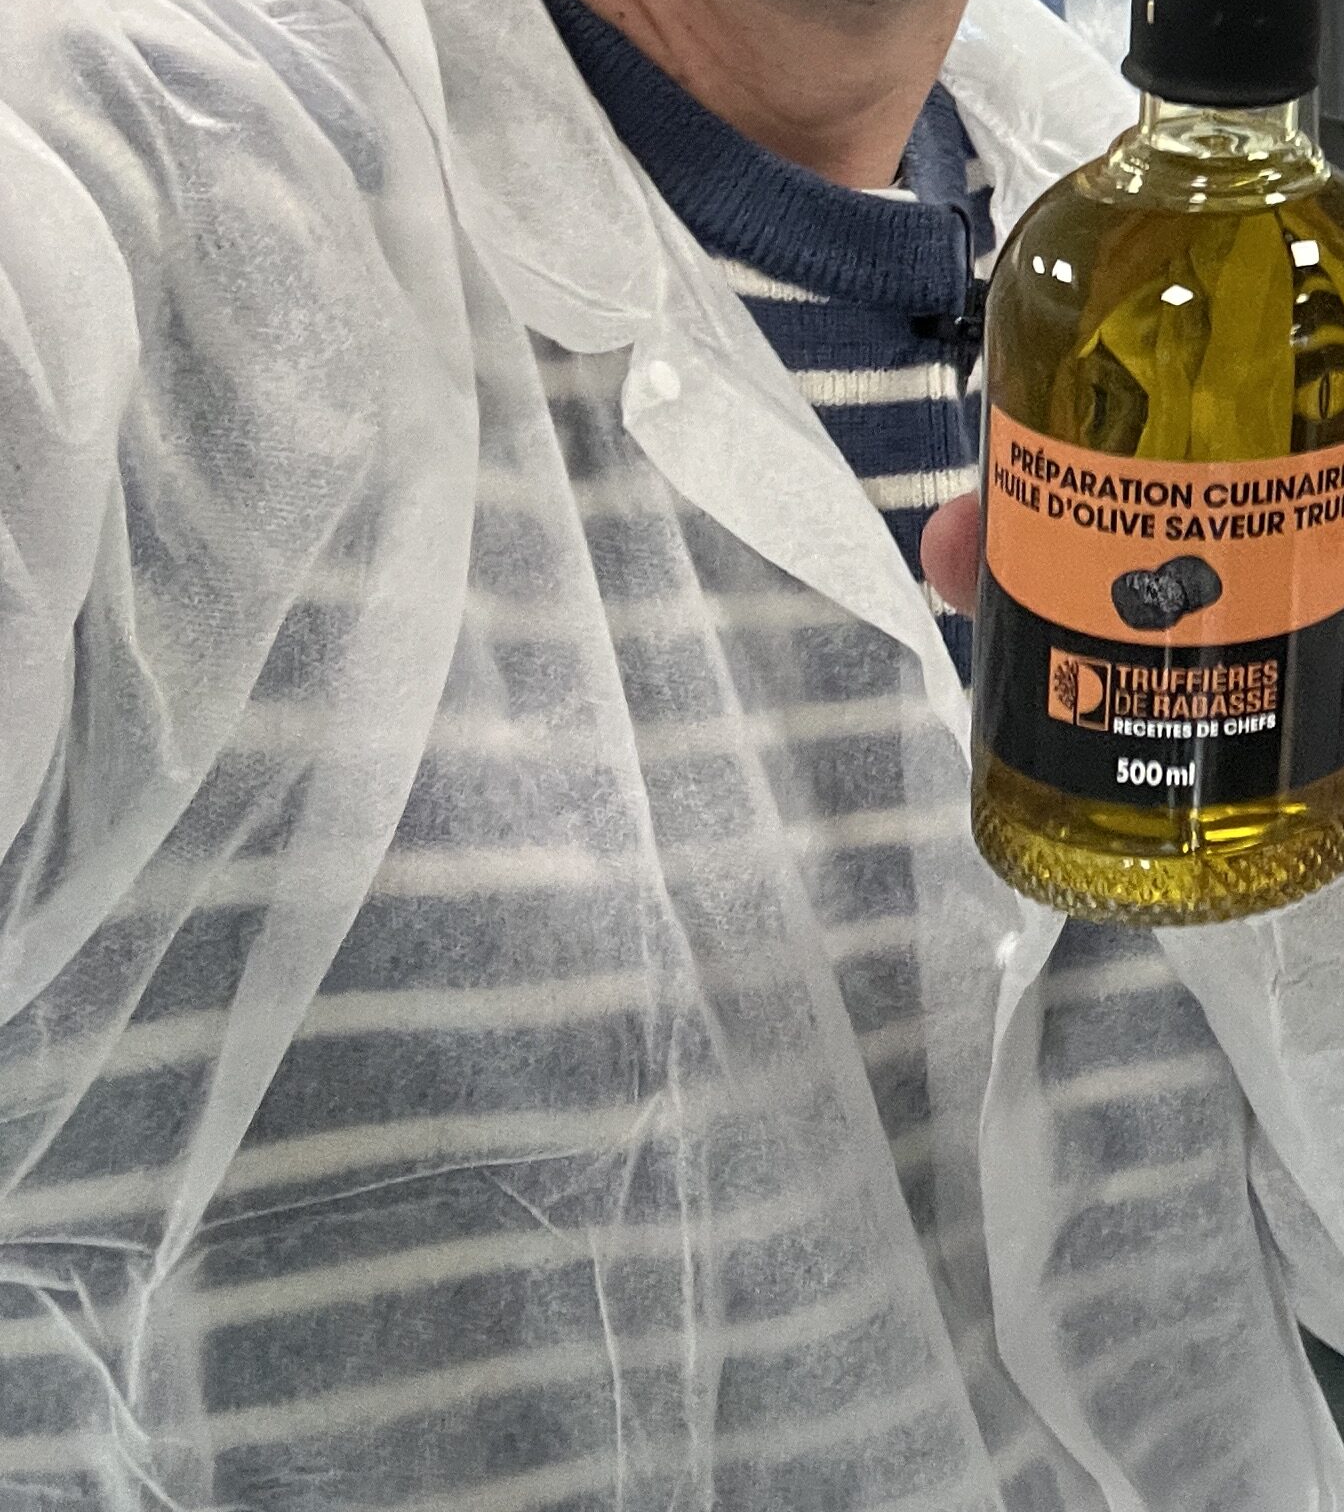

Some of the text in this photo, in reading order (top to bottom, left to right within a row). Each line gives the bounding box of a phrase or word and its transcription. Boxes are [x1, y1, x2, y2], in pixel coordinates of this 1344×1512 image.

[1011, 440, 1193, 509] PRÉPARATION
[994, 460, 1041, 513] HUILE
[1047, 491, 1156, 539] D'OLIVE
[1165, 510, 1285, 541] SAVEUR
[1115, 689, 1148, 718] DE
[1113, 712, 1277, 739] RECETTES DE CHEFS
[1116, 756, 1197, 787] 500 ml
